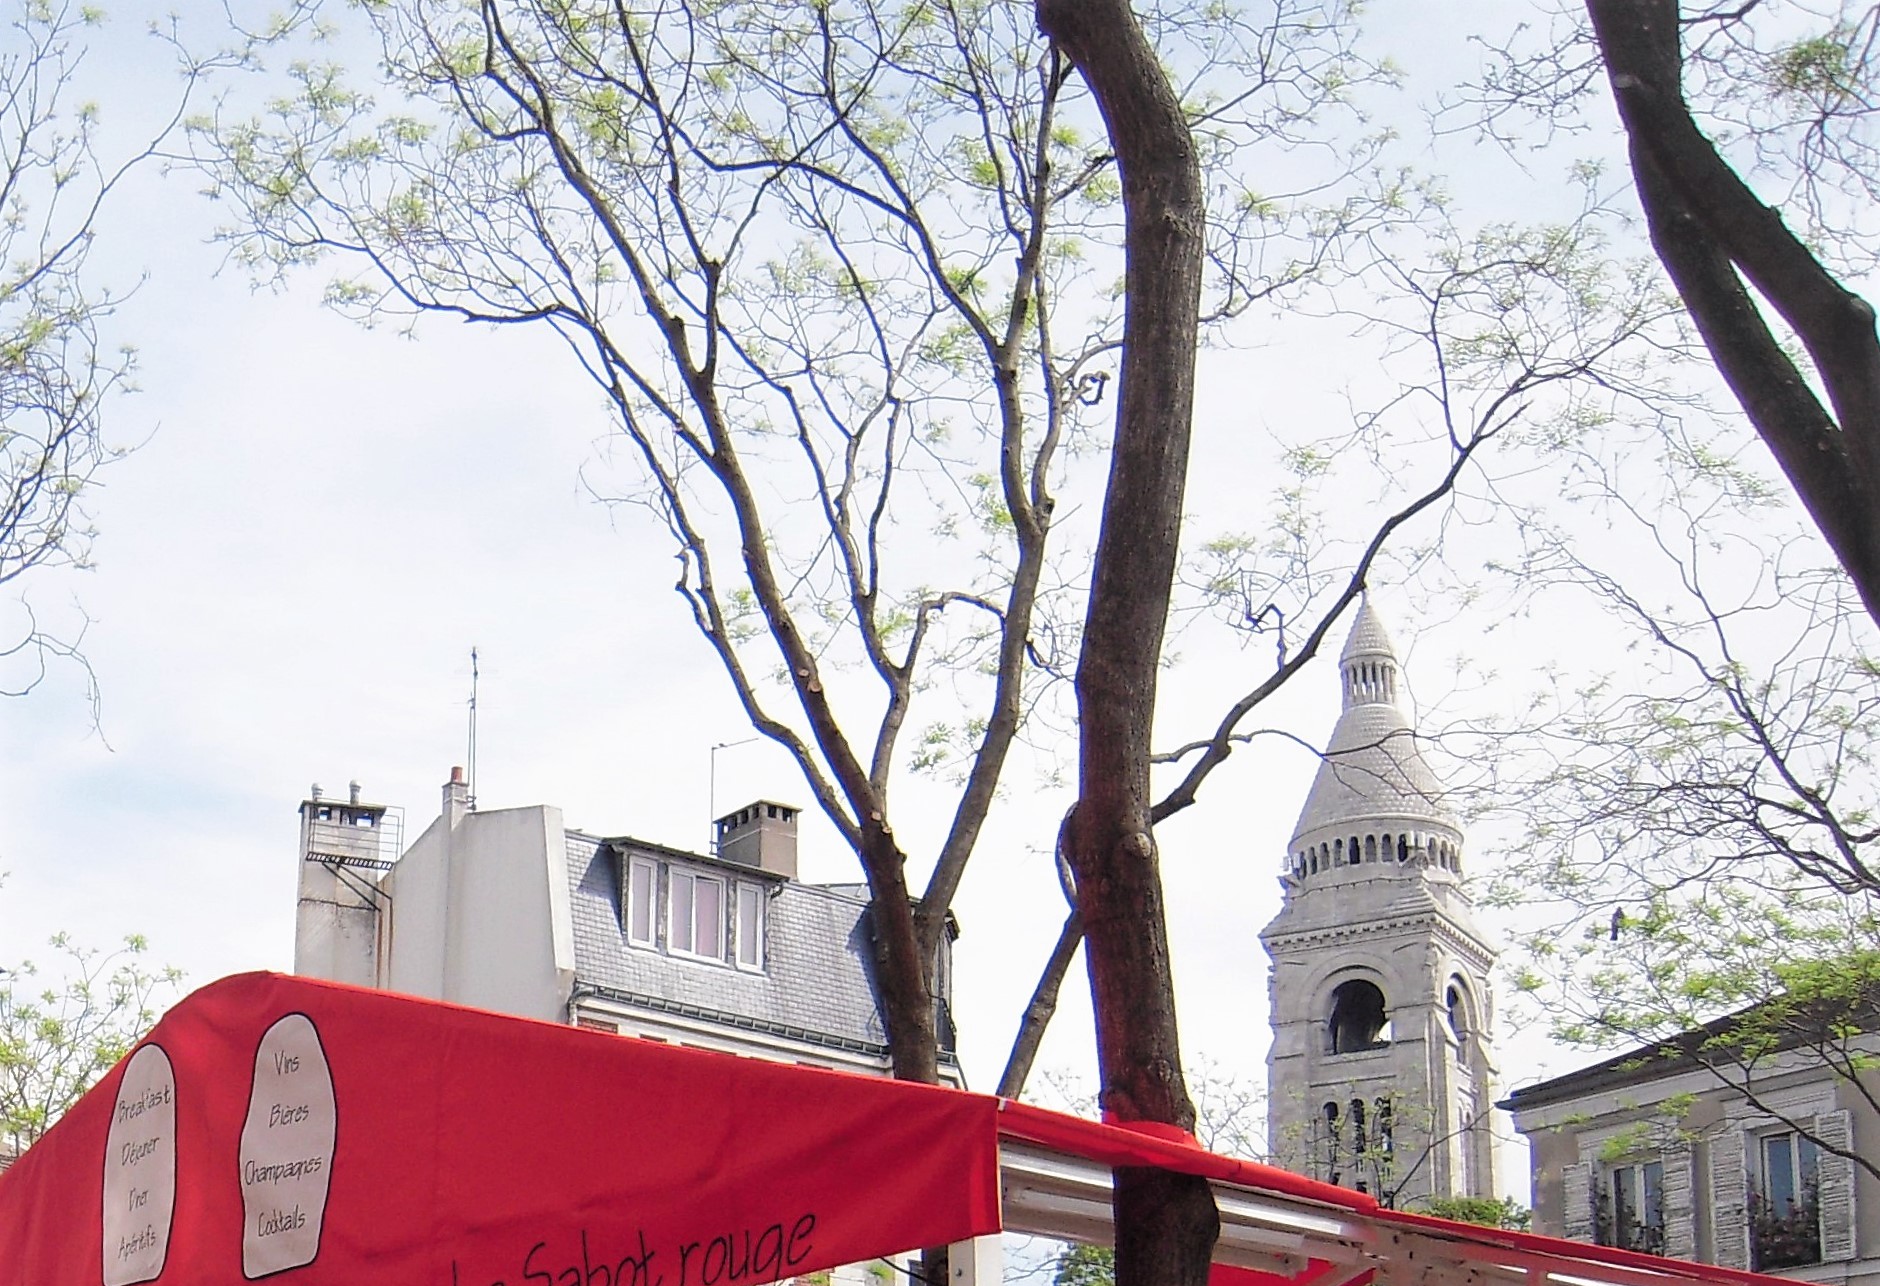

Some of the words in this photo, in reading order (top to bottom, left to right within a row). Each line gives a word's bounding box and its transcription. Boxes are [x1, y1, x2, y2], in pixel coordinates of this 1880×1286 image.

[274, 1049, 300, 1076] Vins
[268, 1103, 310, 1129] Bières
[244, 1156, 322, 1186] Champagnes
[257, 1203, 306, 1237] Cocktails
